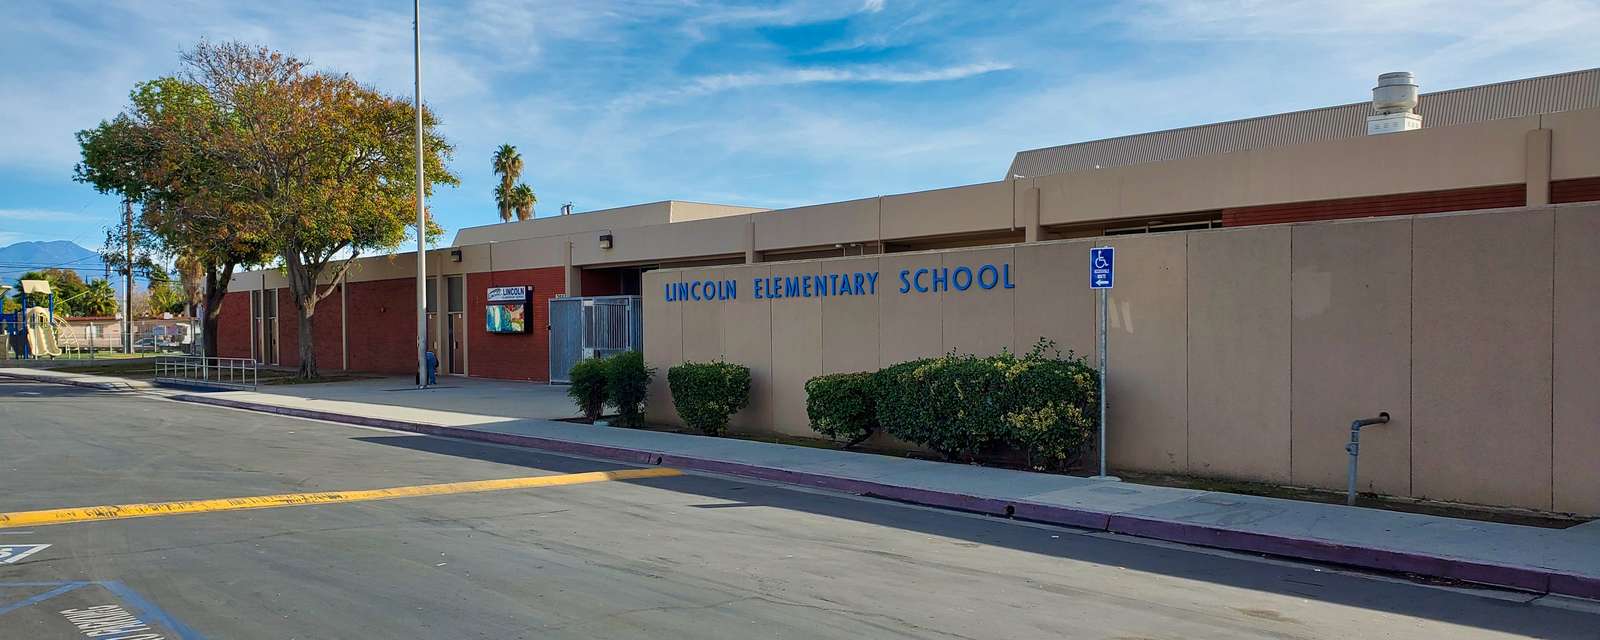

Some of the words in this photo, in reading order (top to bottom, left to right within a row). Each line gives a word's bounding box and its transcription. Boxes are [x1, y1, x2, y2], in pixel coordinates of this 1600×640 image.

[503, 287, 524, 295] LINCOLN
[665, 279, 736, 302] LINCOLN
[754, 271, 879, 299] ELEMENTARY
[899, 263, 1015, 293] SCHOOL
